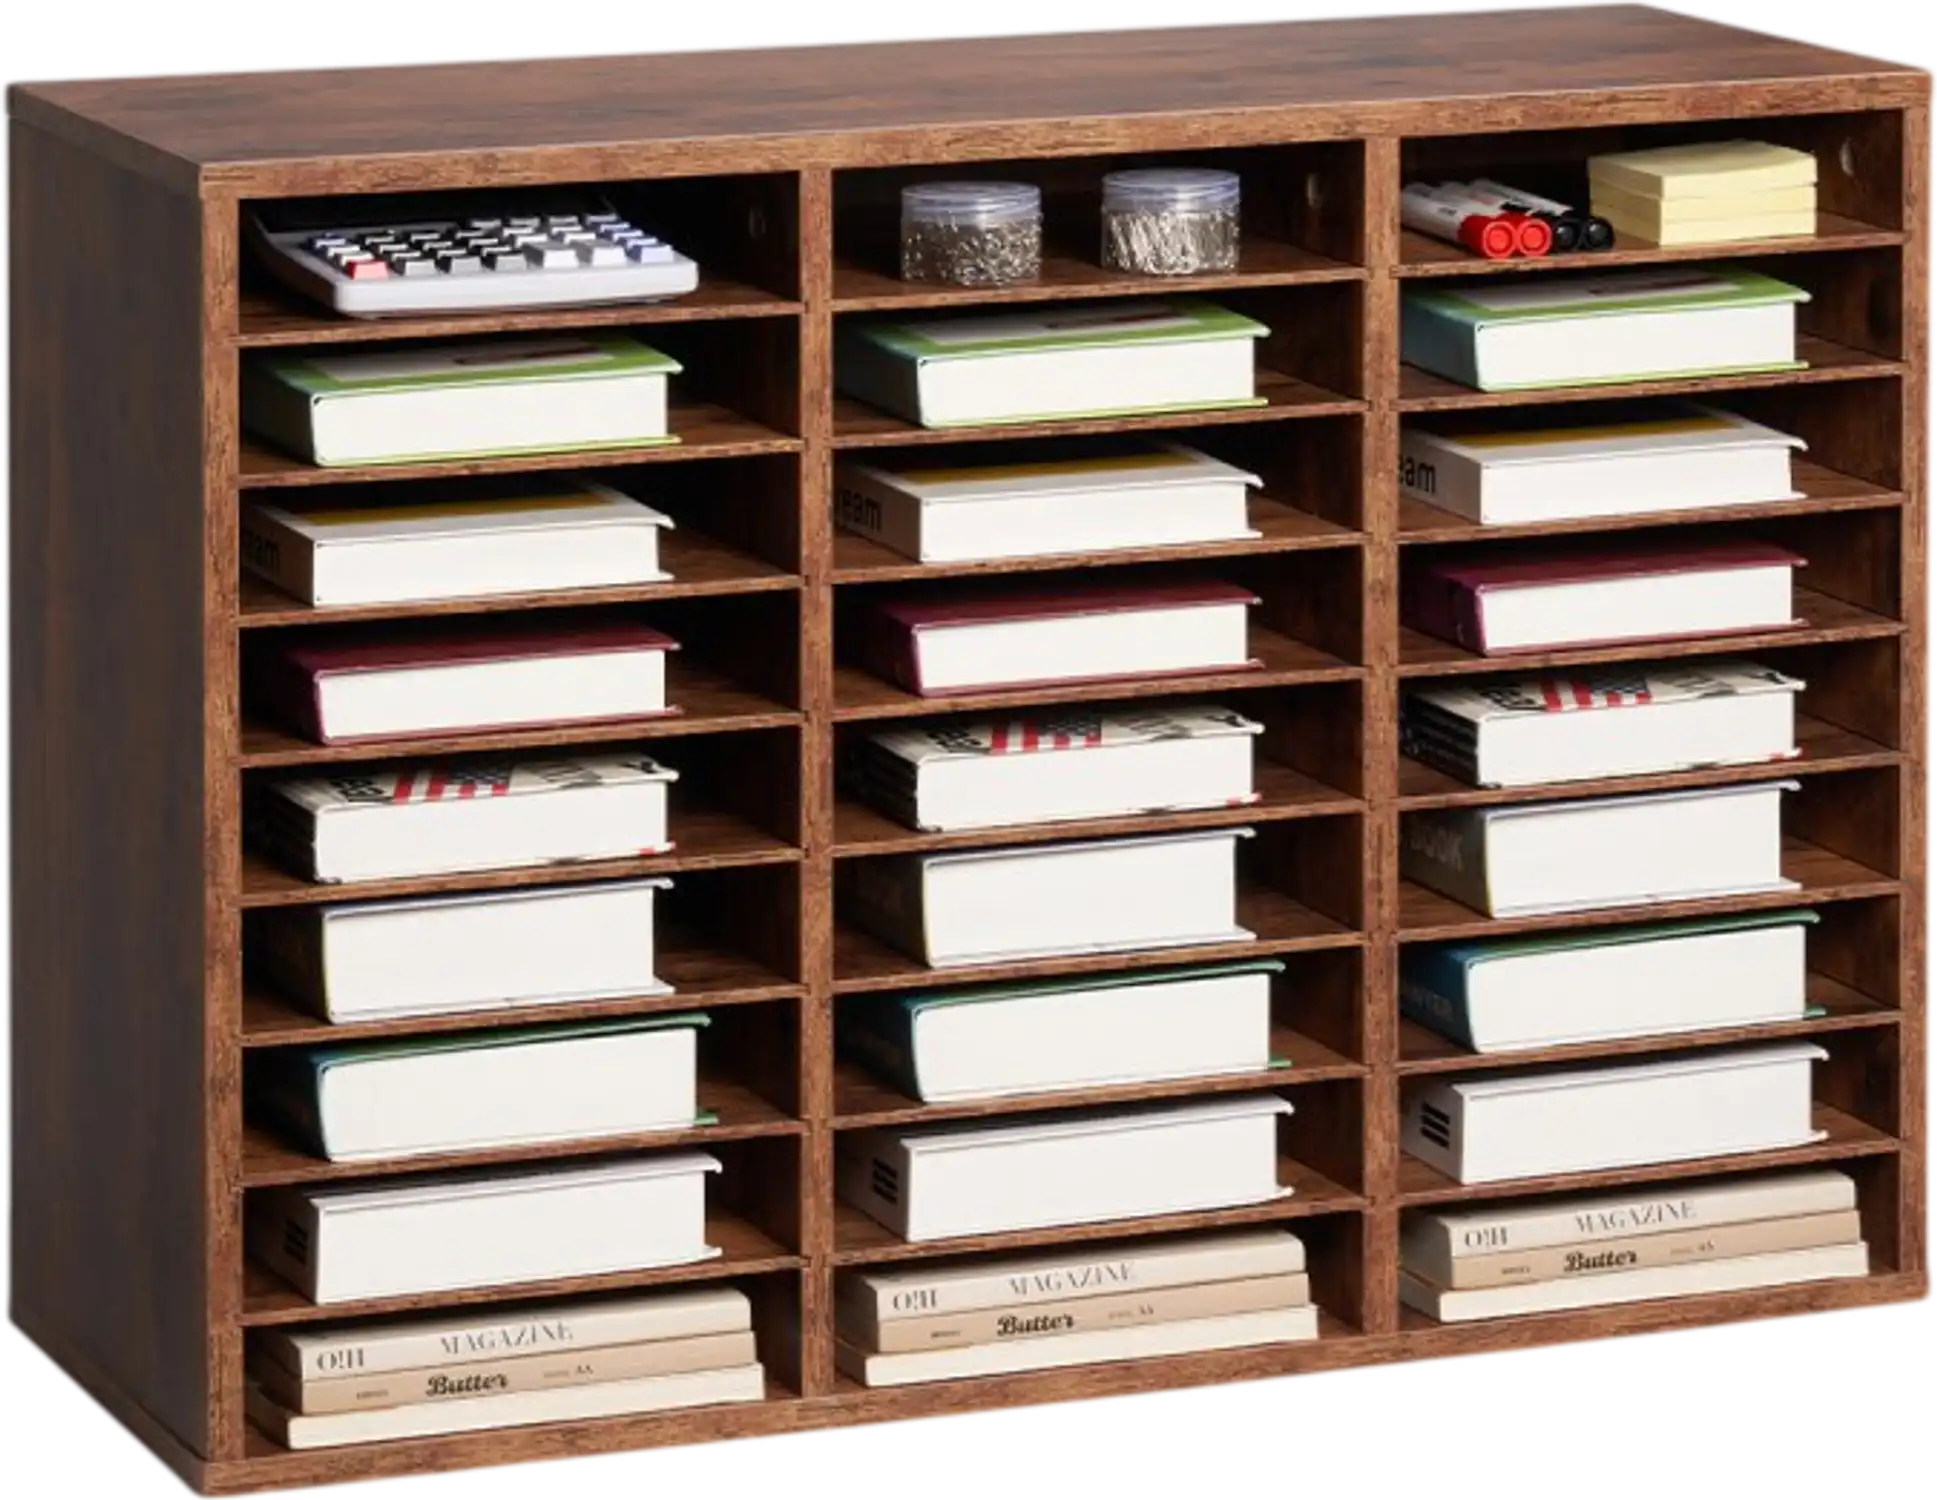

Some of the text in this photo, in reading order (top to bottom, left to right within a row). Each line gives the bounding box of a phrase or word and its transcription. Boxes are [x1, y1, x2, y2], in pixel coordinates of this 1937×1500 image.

[1575, 1200, 1697, 1233] MAGAZINE
[1563, 1249, 1638, 1273] Butter
[1010, 1262, 1135, 1295] MAGAZINE
[440, 1321, 574, 1355] MAGAZINE
[996, 1312, 1075, 1337] Butter
[425, 1372, 509, 1398] Butter
